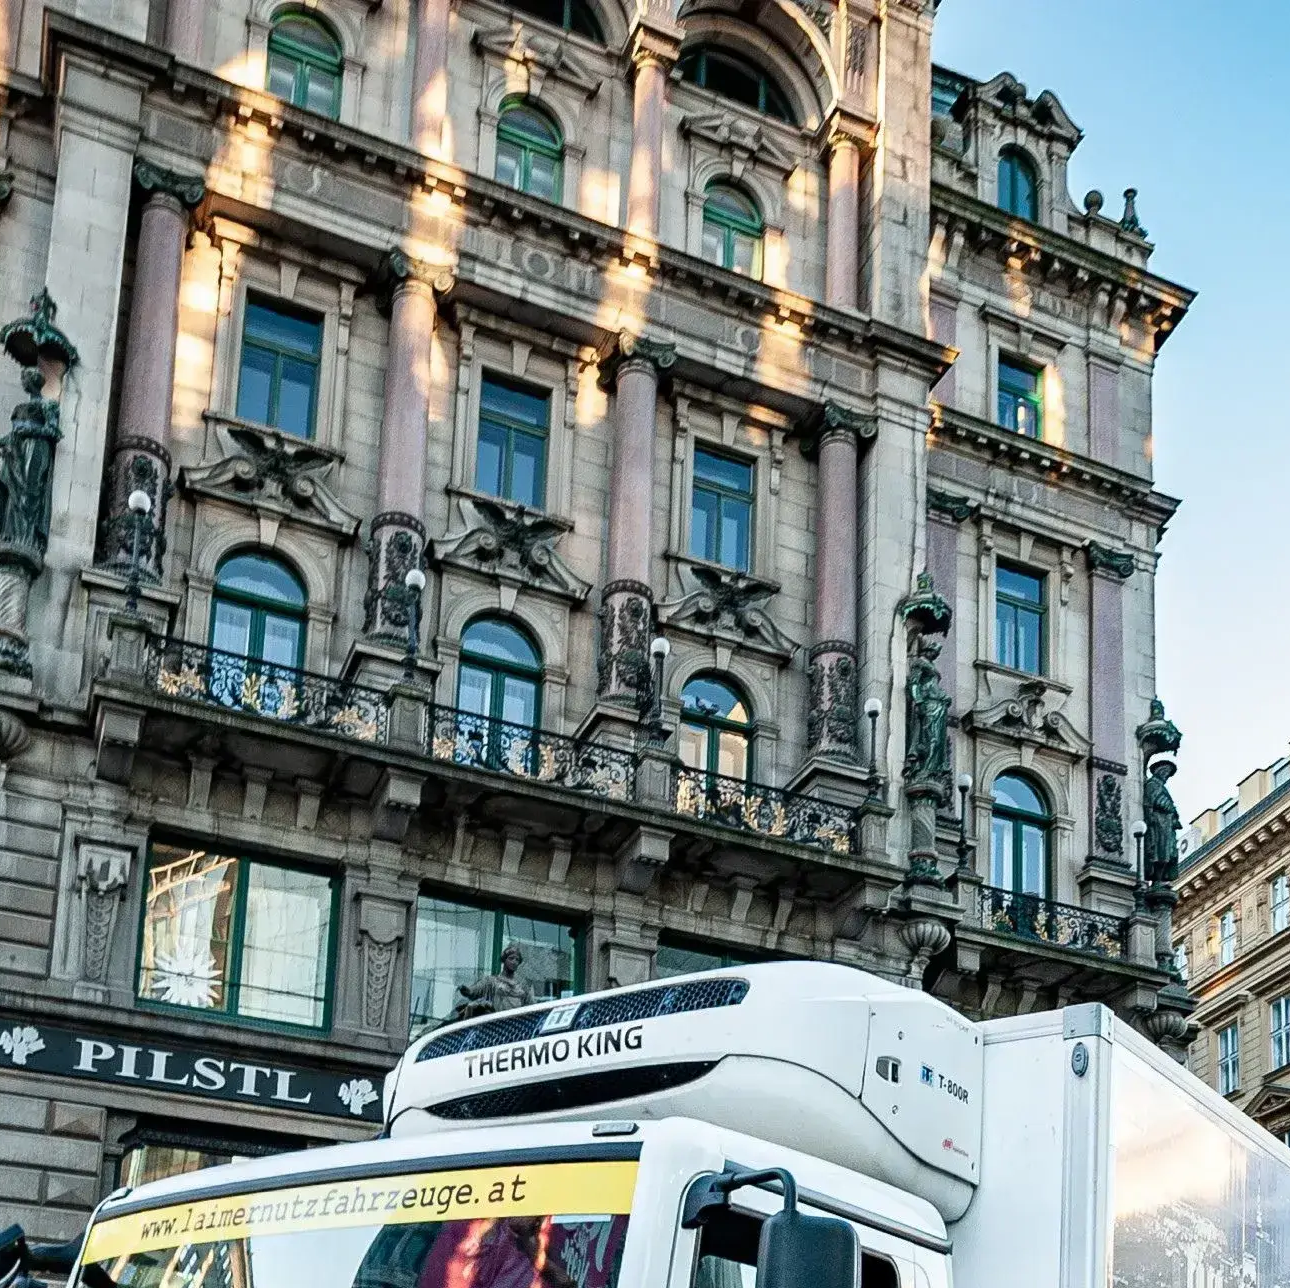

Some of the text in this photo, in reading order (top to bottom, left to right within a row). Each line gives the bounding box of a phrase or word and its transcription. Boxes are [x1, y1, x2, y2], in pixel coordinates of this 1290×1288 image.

[72, 1038, 312, 1104] PILSTL
[464, 1025, 643, 1079] THERMO KING
[938, 1073, 969, 1105] T-800R
[140, 1172, 527, 1241] www.laimernutzfahrzeuge.at
